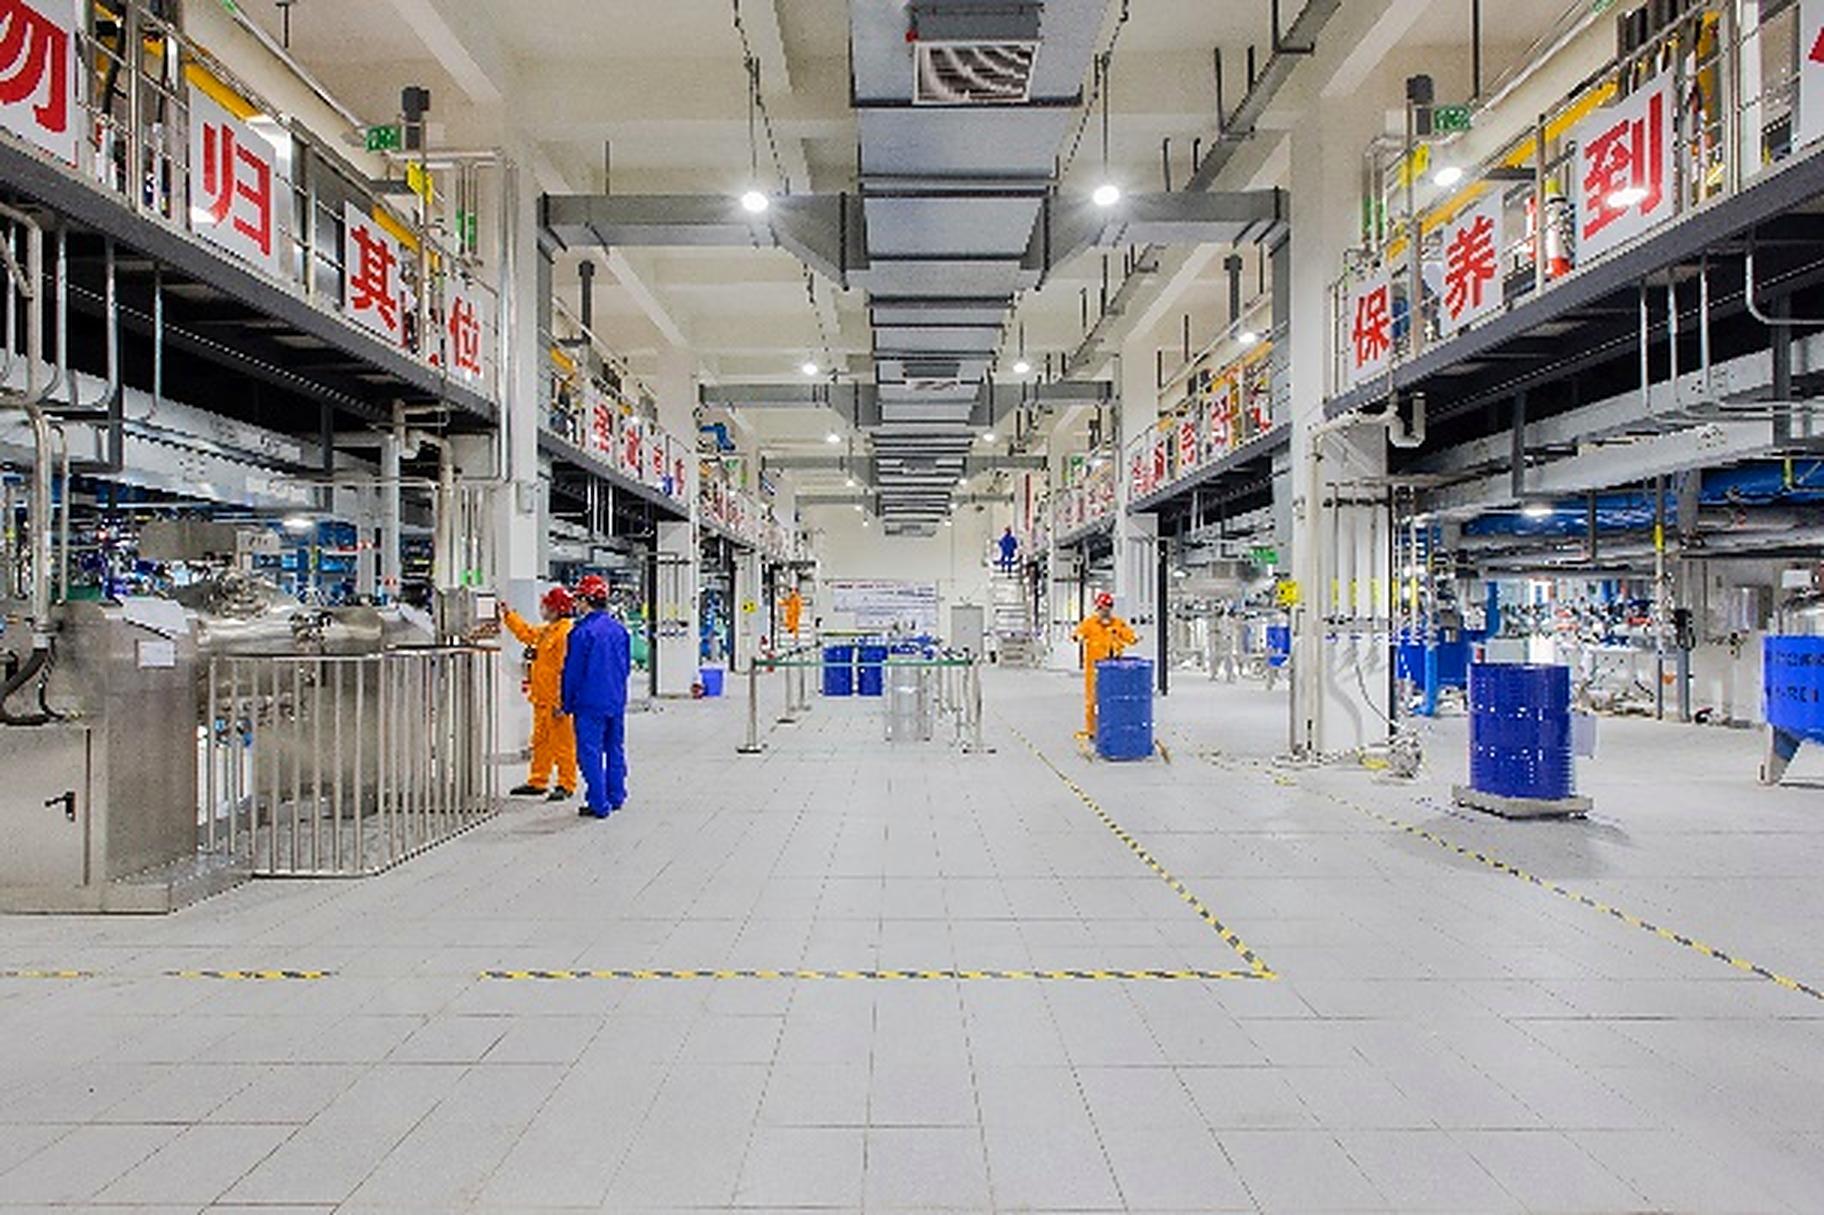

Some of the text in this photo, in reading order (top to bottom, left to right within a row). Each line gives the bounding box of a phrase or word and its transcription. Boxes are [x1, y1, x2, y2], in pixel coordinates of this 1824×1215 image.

[203, 122, 480, 374] 归 其 位
[1353, 92, 1663, 368] 保 养 到
